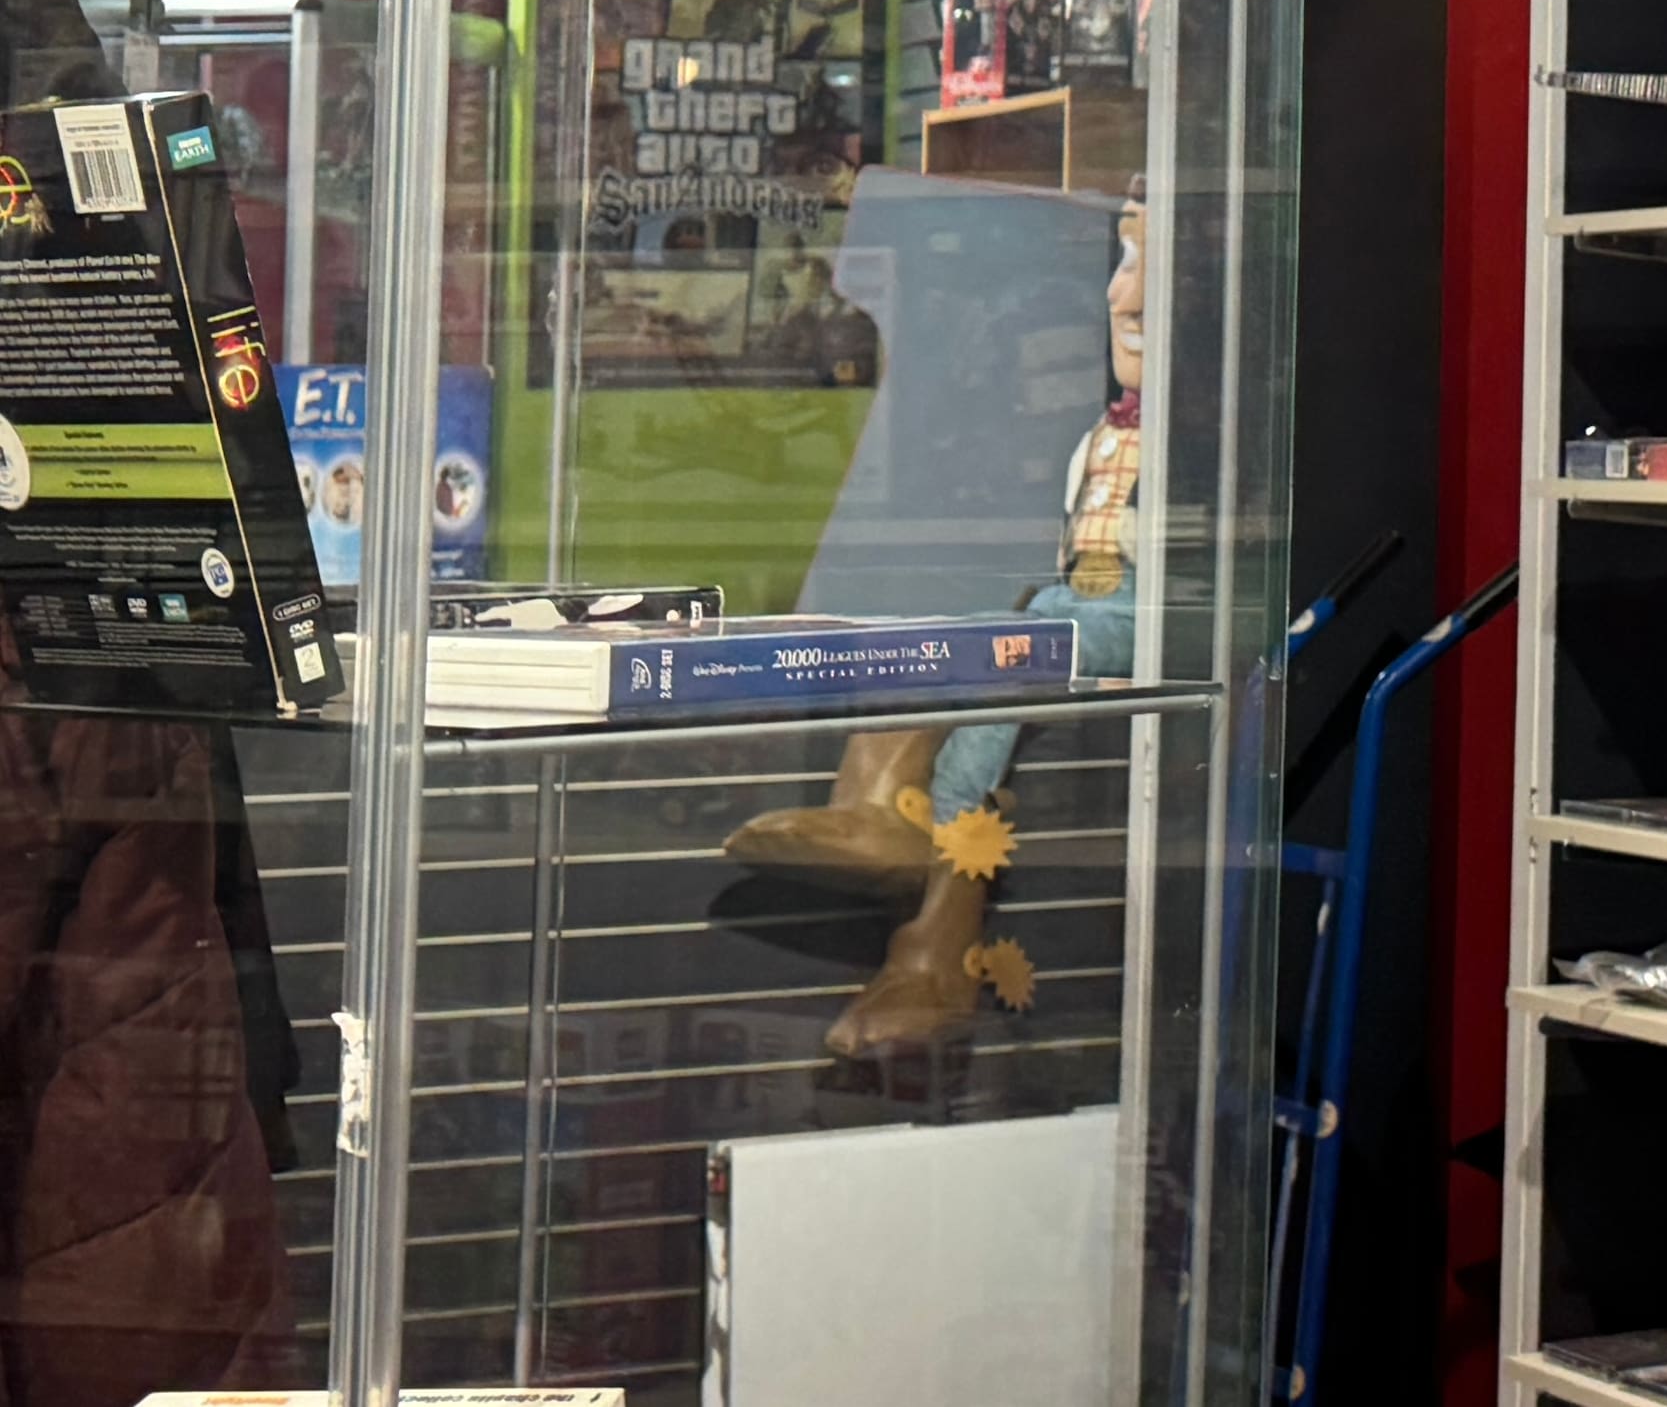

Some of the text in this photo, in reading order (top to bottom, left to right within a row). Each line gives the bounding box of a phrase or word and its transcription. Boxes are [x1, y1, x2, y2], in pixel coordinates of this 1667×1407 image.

[622, 37, 775, 90] grand
[647, 91, 797, 134] theft
[175, 143, 209, 162] EARTH
[635, 134, 760, 174] auto
[294, 369, 364, 426] E.T.
[868, 649, 898, 661] UNDER
[900, 648, 919, 660] THE
[920, 641, 950, 660] SEA
[710, 663, 737, 677] Disney
[786, 663, 938, 681] SPECIAL EDITION
